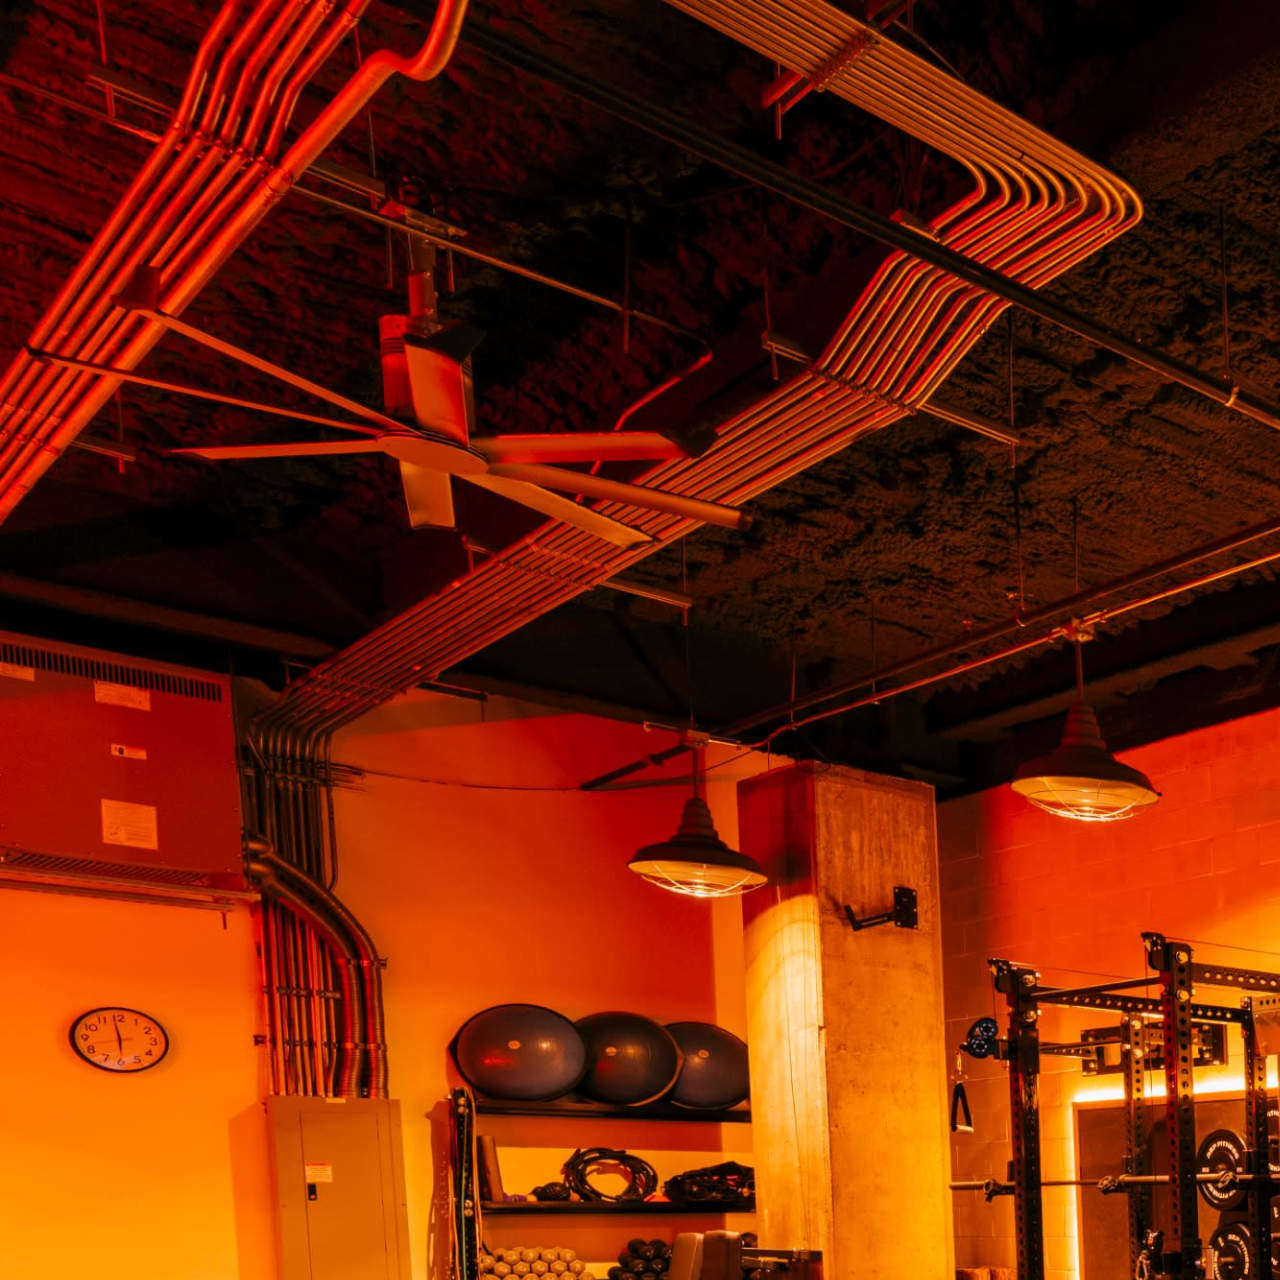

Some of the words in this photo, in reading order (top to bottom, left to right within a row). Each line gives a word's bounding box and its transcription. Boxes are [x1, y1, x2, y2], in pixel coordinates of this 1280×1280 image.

[97, 1016, 107, 1024] 11
[85, 1023, 98, 1032] 10
[144, 1026, 152, 1035] 2
[81, 1033, 89, 1042] 9
[150, 1037, 157, 1046] 3
[86, 1045, 96, 1054] 8
[102, 1053, 110, 1062] 7
[117, 1058, 125, 1066] 6
[133, 1055, 141, 1064] 5
